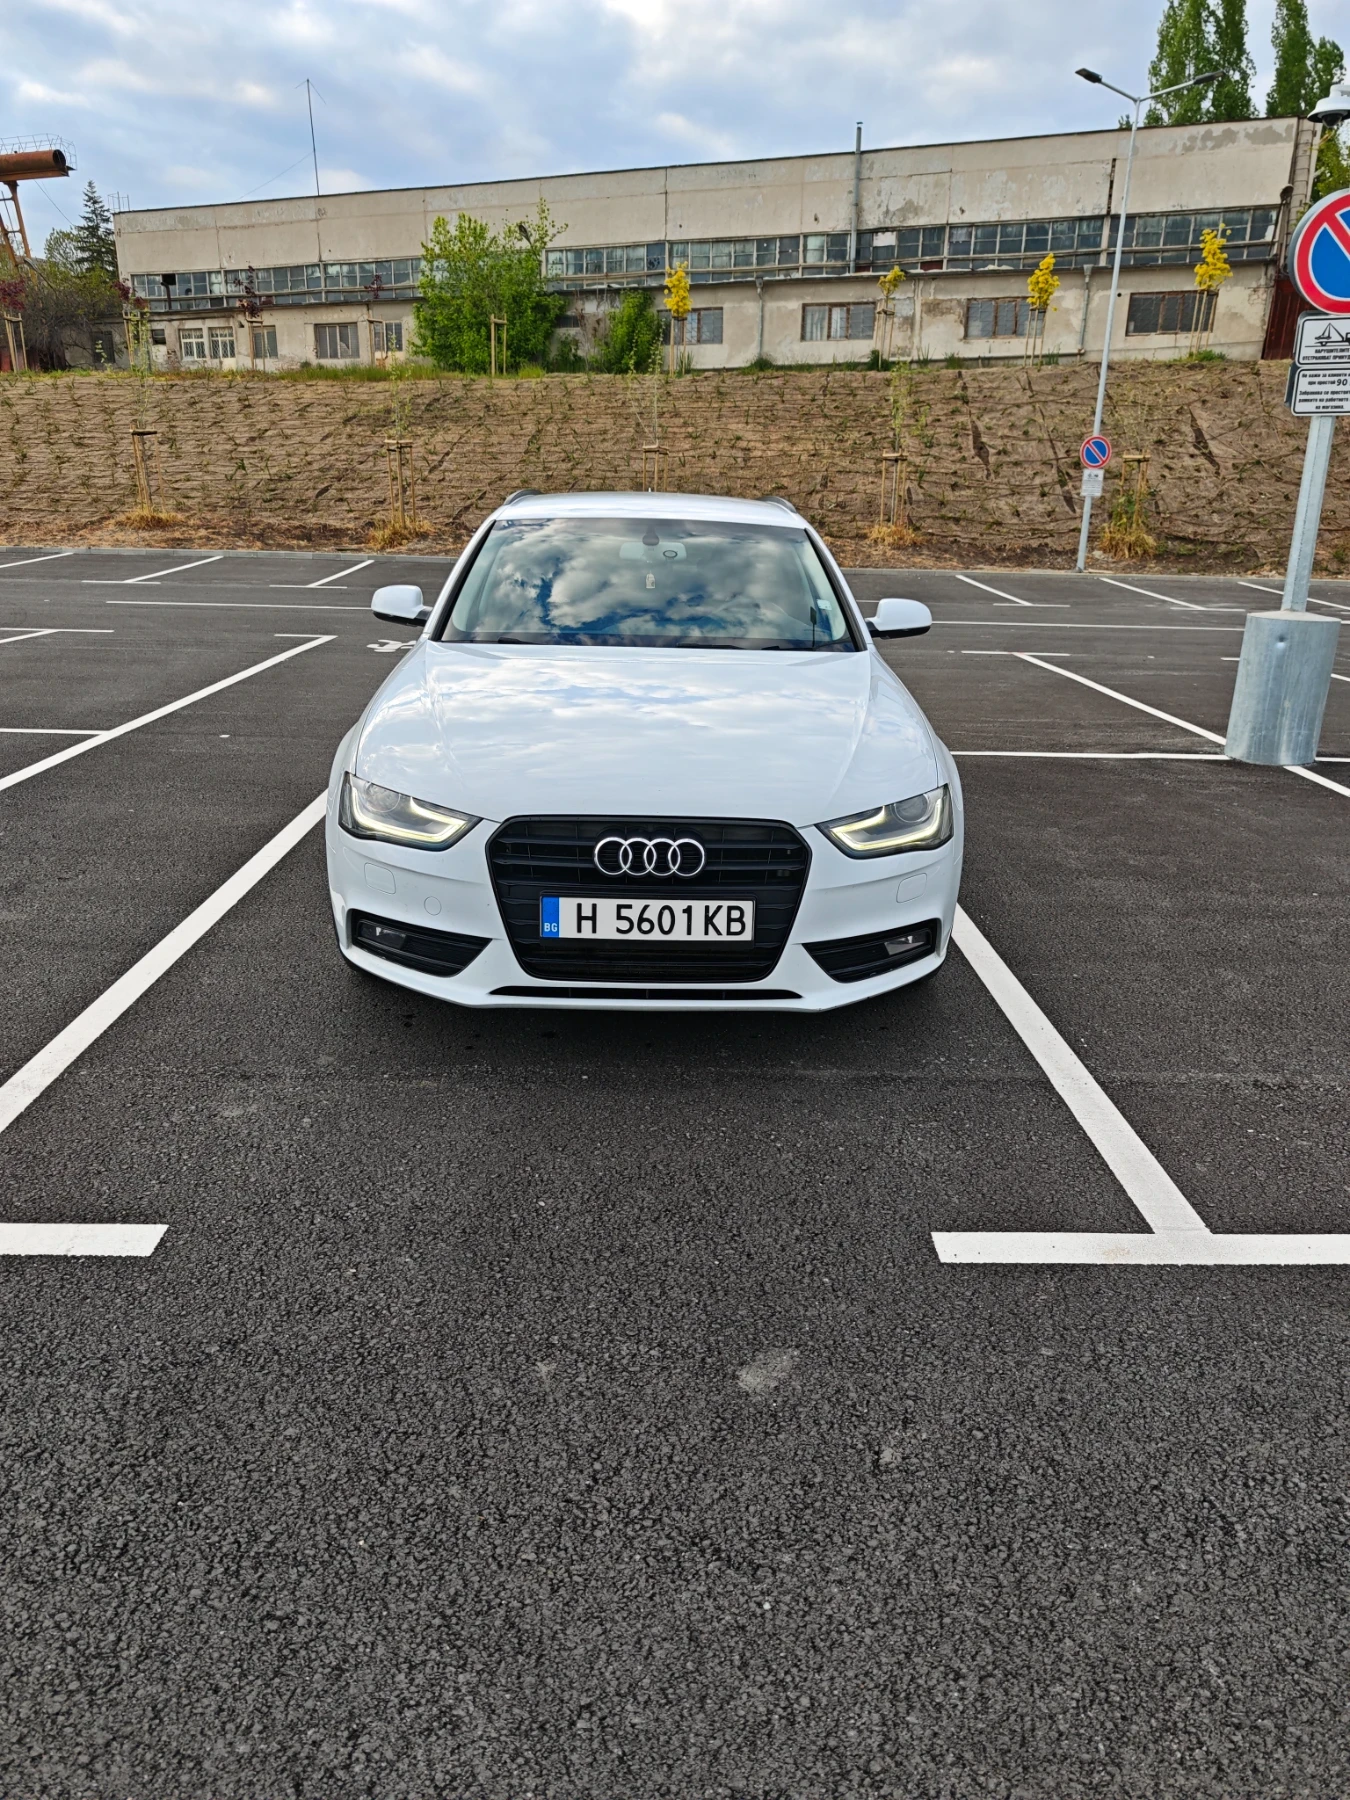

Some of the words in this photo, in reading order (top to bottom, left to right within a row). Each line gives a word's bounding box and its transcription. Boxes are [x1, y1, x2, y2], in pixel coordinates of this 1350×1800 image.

[1337, 378, 1348, 386] 90
[576, 903, 597, 934] H
[544, 923, 557, 932] BG
